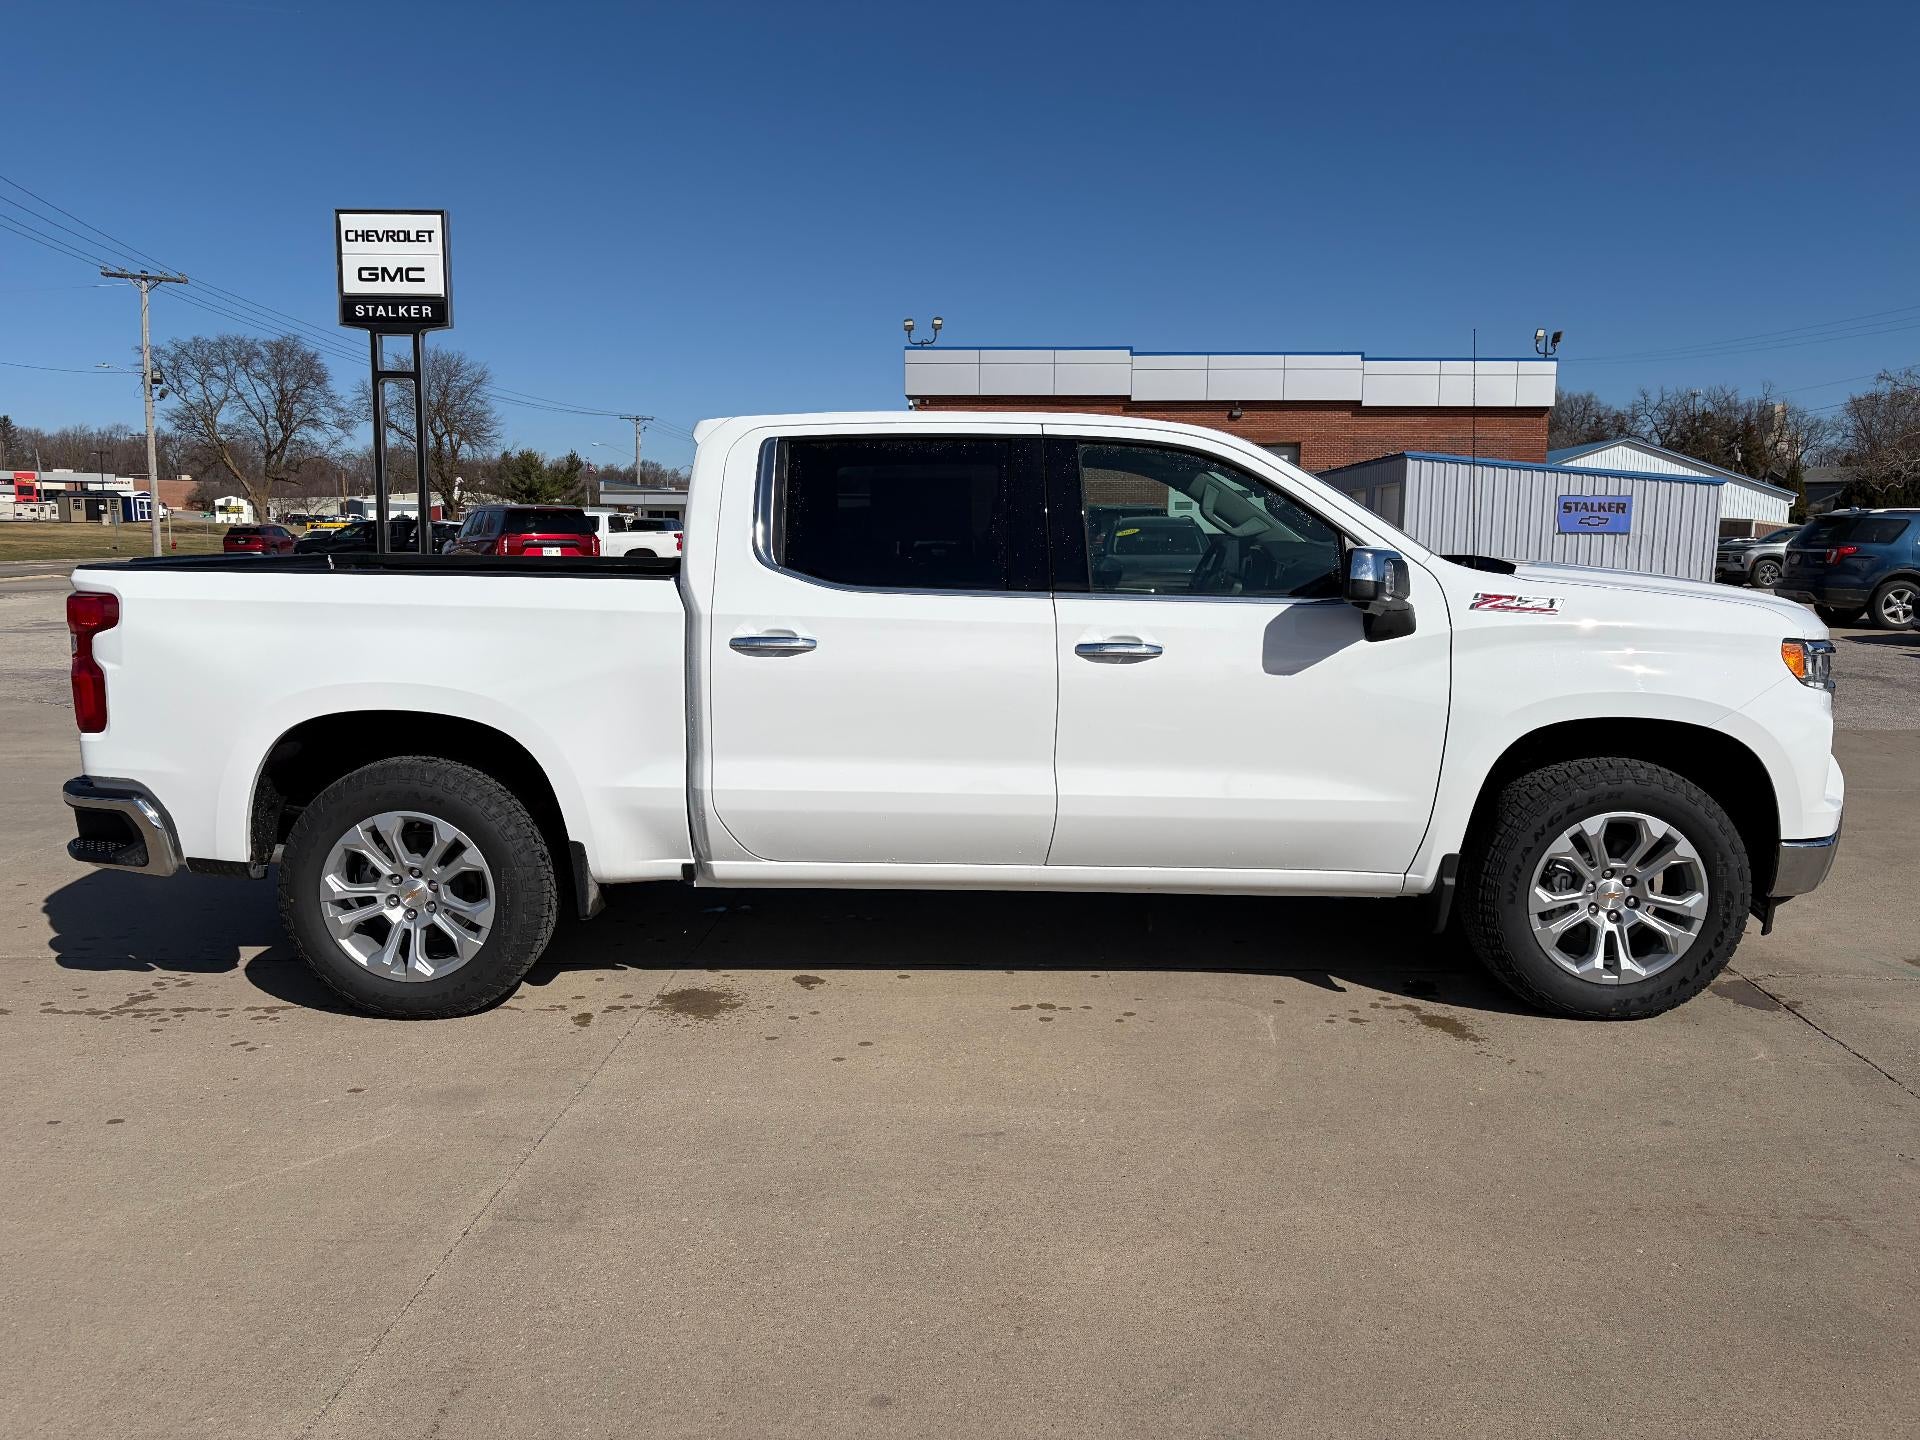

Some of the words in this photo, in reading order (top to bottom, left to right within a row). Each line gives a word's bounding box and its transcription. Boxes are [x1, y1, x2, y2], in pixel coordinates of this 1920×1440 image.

[345, 229, 434, 243] CHEVROLET
[357, 266, 426, 283] GMC
[355, 304, 432, 318] STALKER
[1562, 501, 1627, 514] STALKER
[1506, 791, 1625, 905] WRANGLER
